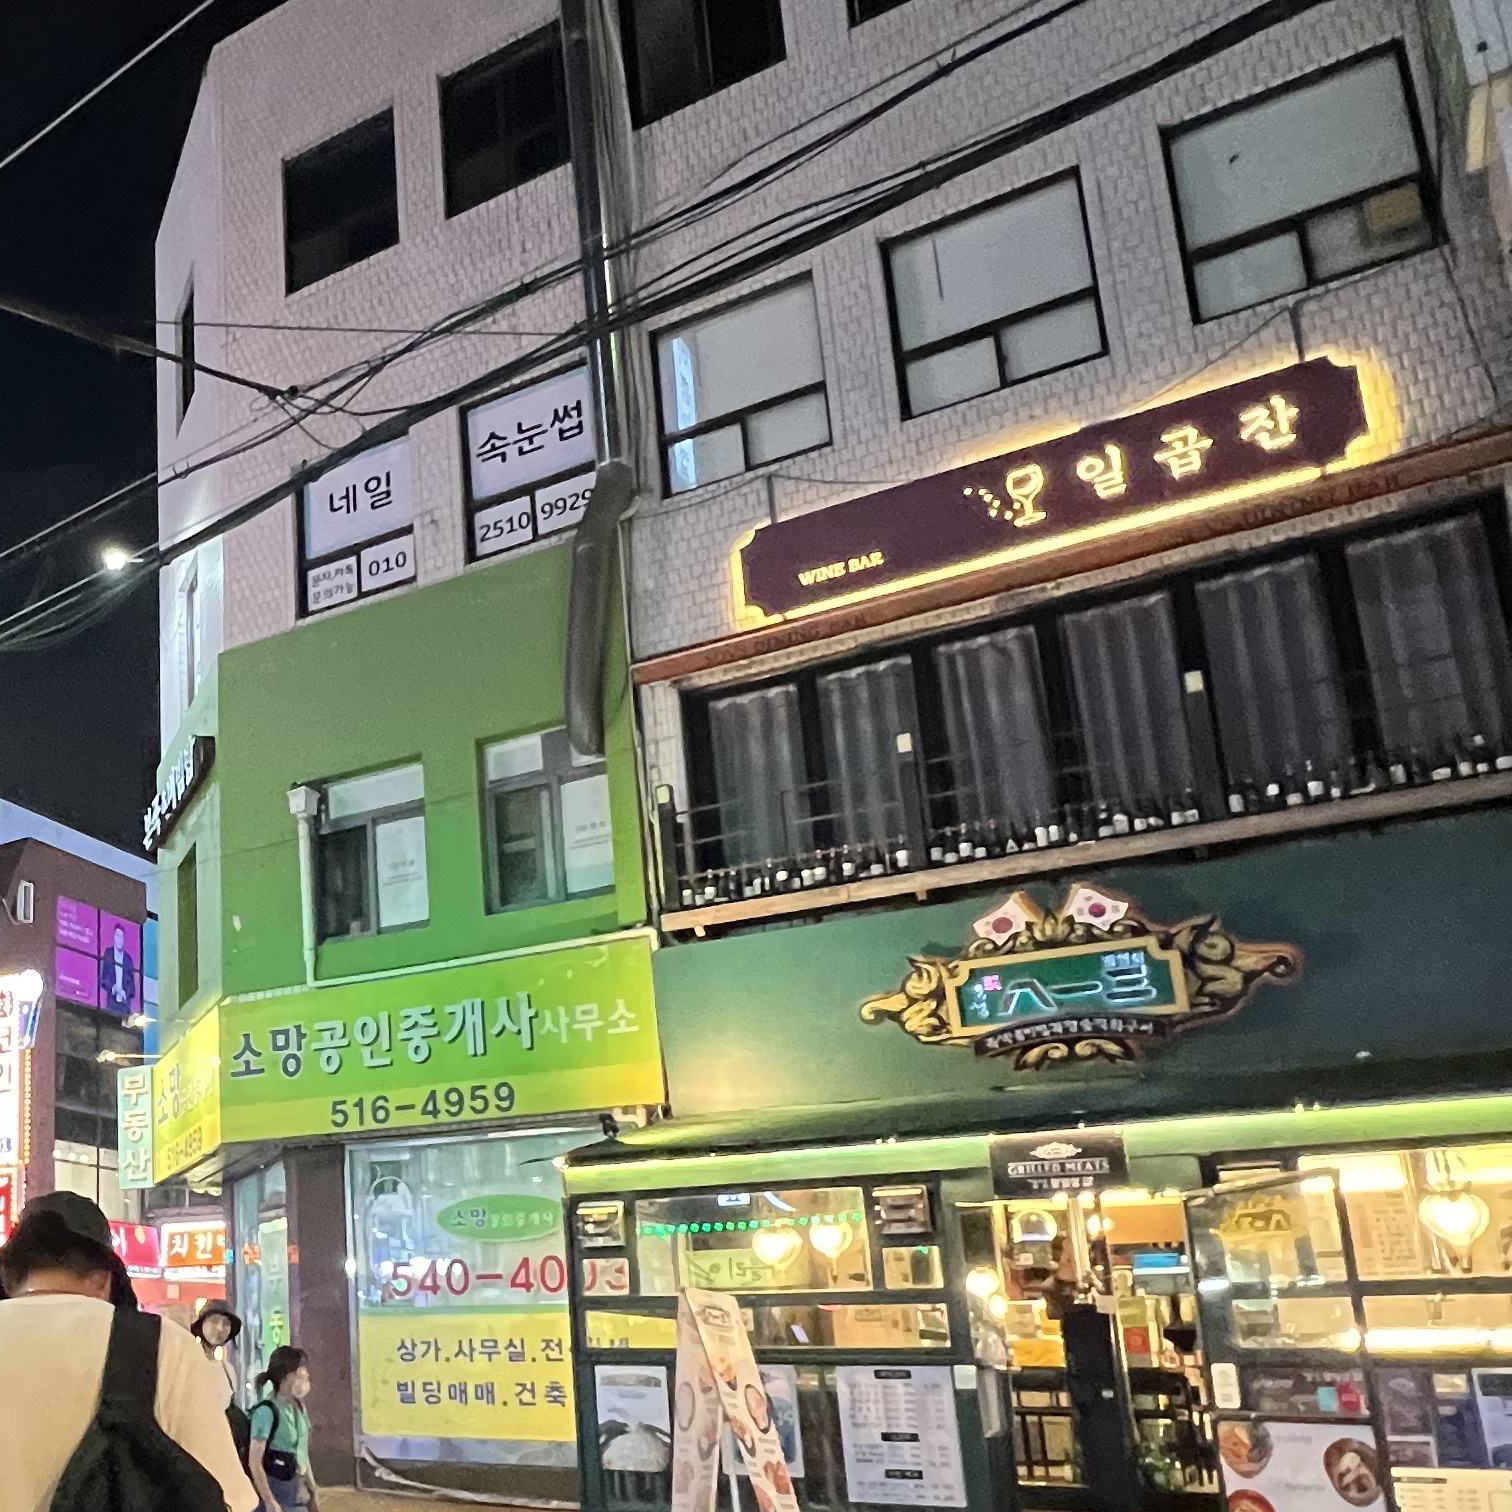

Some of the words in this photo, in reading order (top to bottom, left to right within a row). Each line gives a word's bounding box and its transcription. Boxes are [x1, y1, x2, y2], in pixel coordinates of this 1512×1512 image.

[476, 399, 584, 463] 속눈썹
[329, 471, 393, 514] 네일
[479, 511, 530, 542] 2510
[368, 551, 407, 576] 010
[798, 561, 846, 586] WINE
[848, 551, 884, 573] BAR
[330, 1081, 517, 1128] 516-4959
[121, 1073, 151, 1182] 부동산
